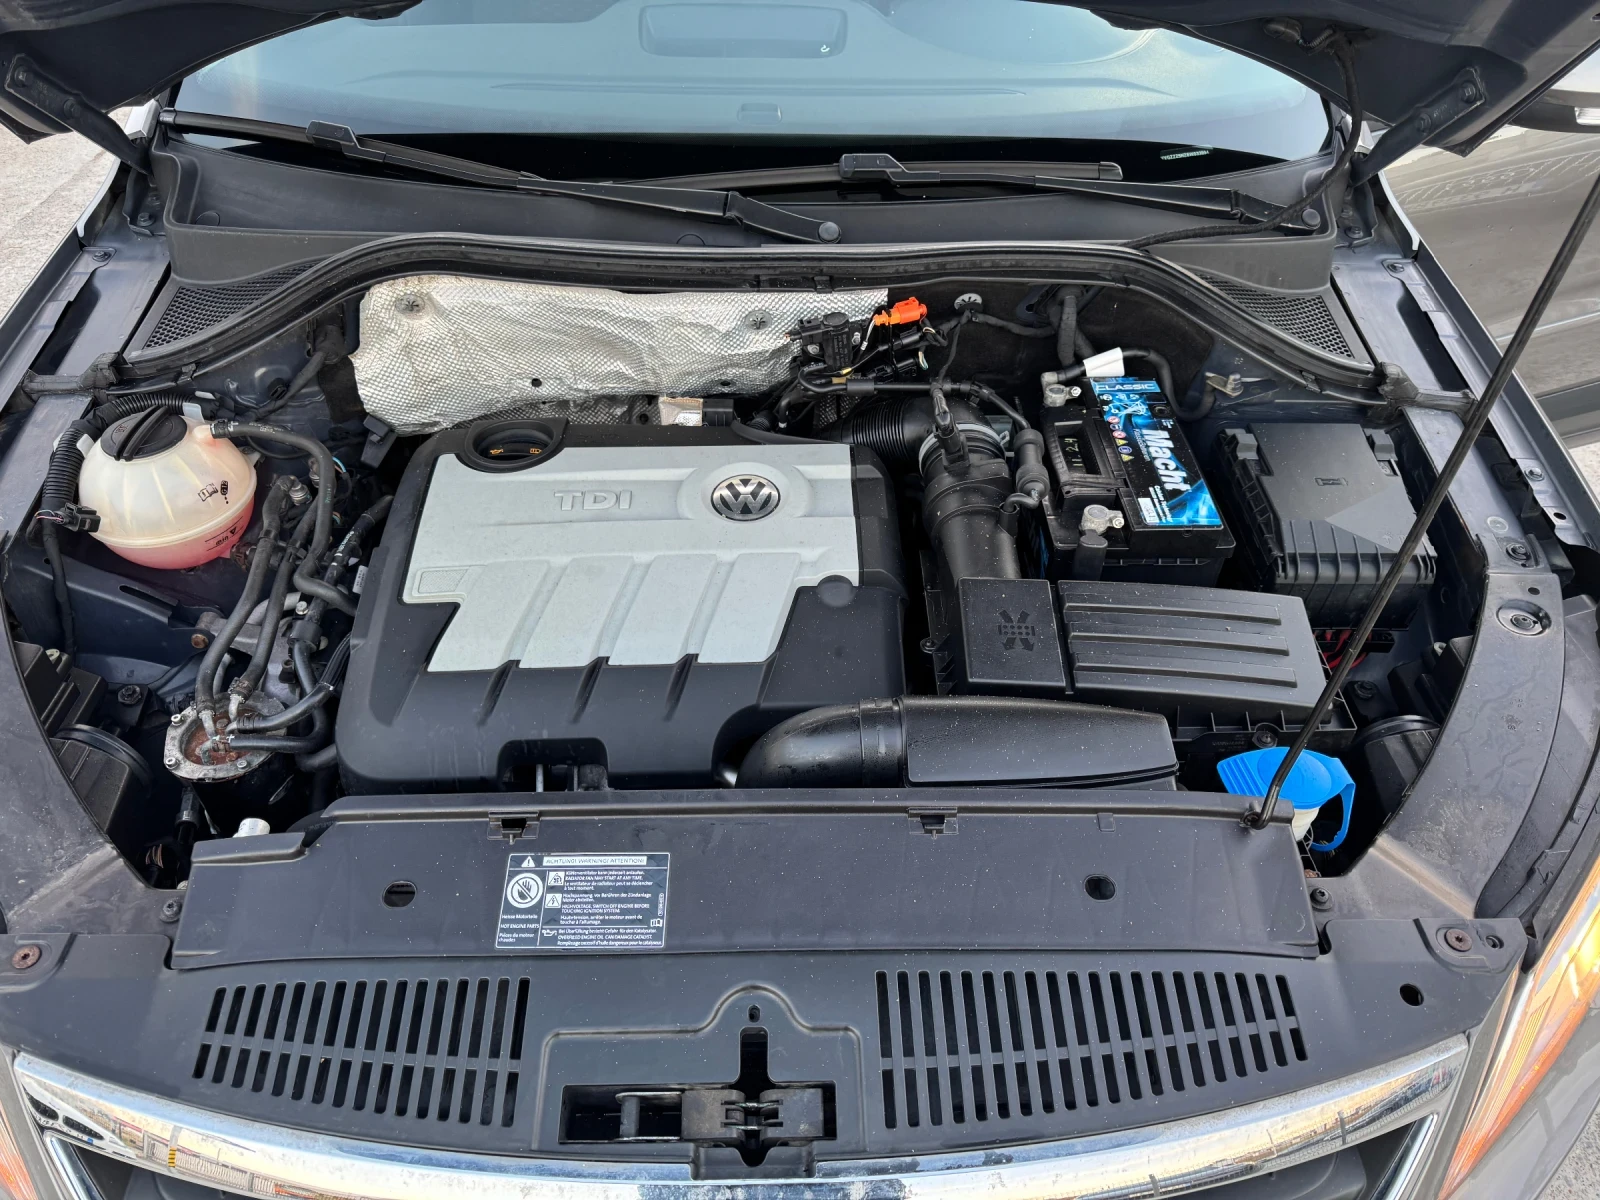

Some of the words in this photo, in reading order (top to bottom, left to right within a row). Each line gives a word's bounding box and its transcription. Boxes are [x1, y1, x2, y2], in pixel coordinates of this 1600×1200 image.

[1096, 383, 1156, 391] CLASSIC
[1141, 429, 1193, 492] Macht
[554, 490, 633, 511] TDI
[215, 536, 230, 547] min
